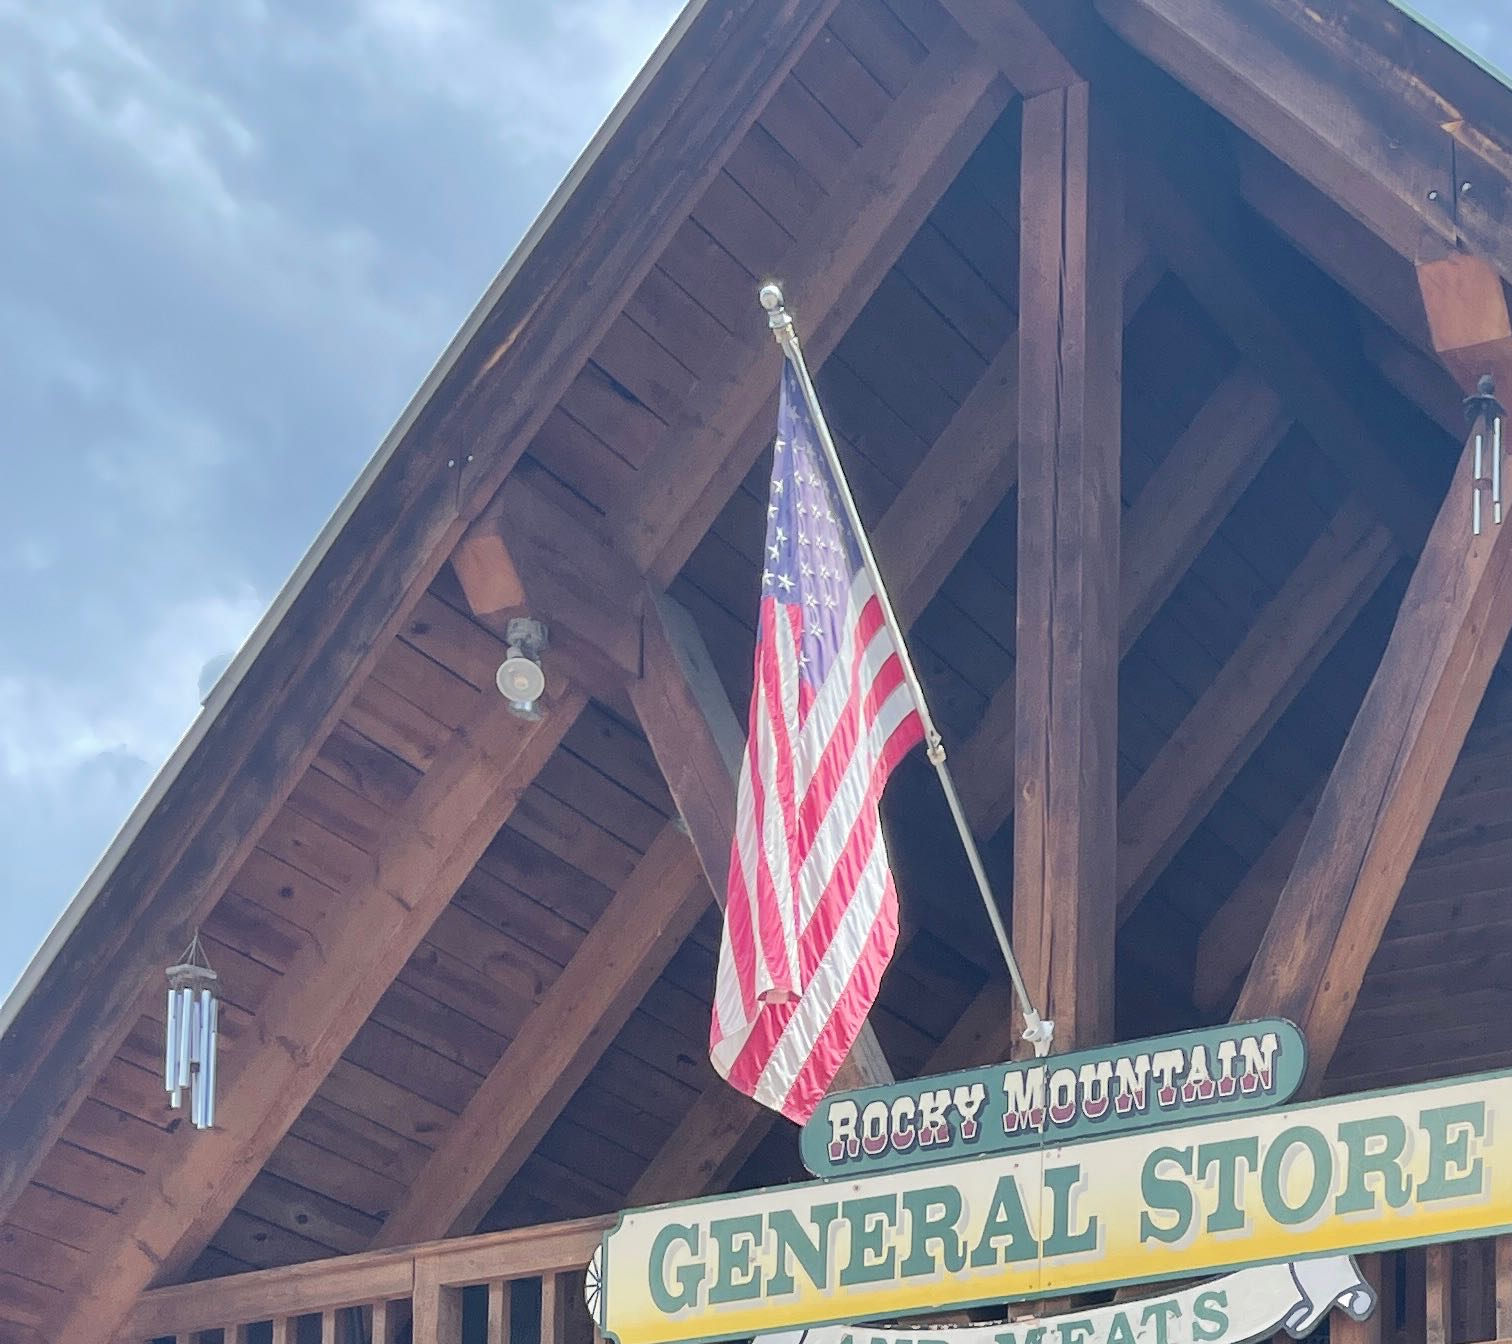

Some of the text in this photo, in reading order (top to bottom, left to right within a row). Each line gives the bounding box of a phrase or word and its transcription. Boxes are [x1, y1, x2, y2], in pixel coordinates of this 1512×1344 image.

[828, 1033, 1280, 1162] ROCKY MOUNTAIN
[647, 1102, 1488, 1317] GENERAL STORE
